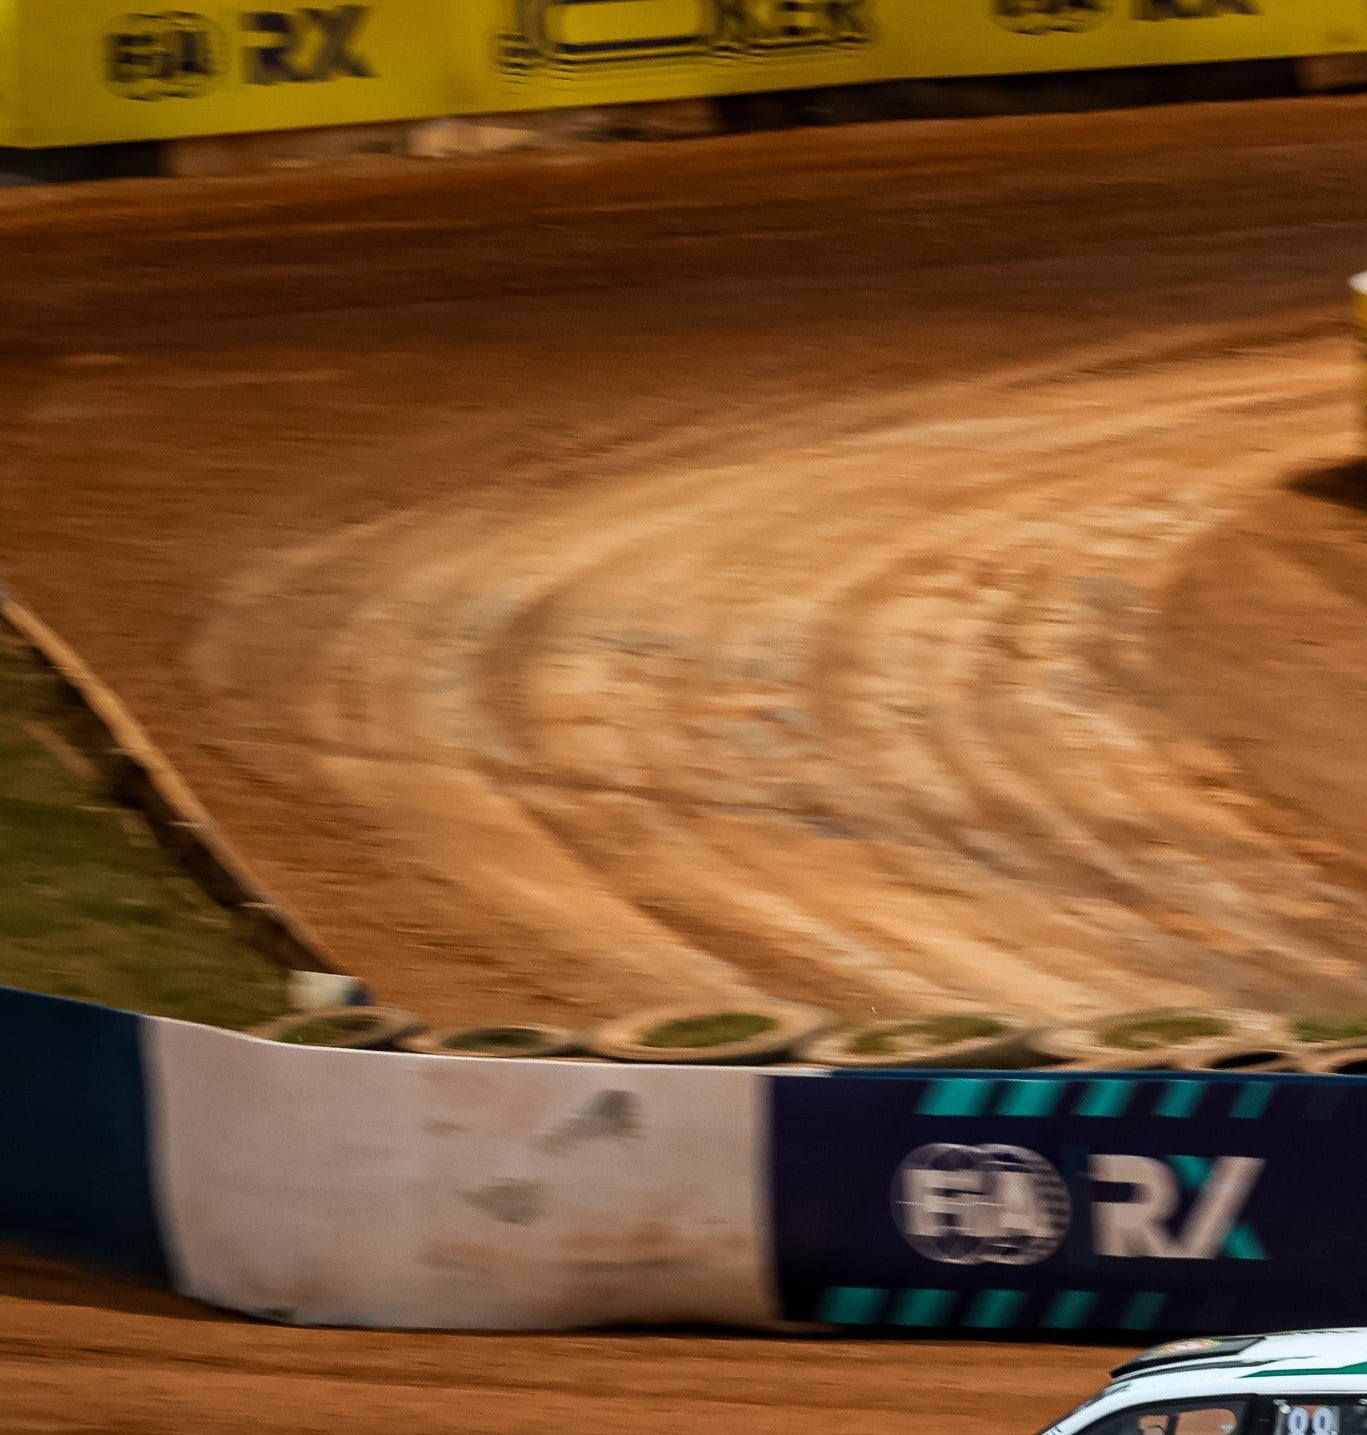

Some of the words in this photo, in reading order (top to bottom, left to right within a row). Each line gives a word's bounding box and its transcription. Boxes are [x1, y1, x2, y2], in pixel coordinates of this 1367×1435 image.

[241, 4, 380, 85] RX
[904, 1169, 1055, 1238] FIA
[1089, 1154, 1270, 1259] RX
